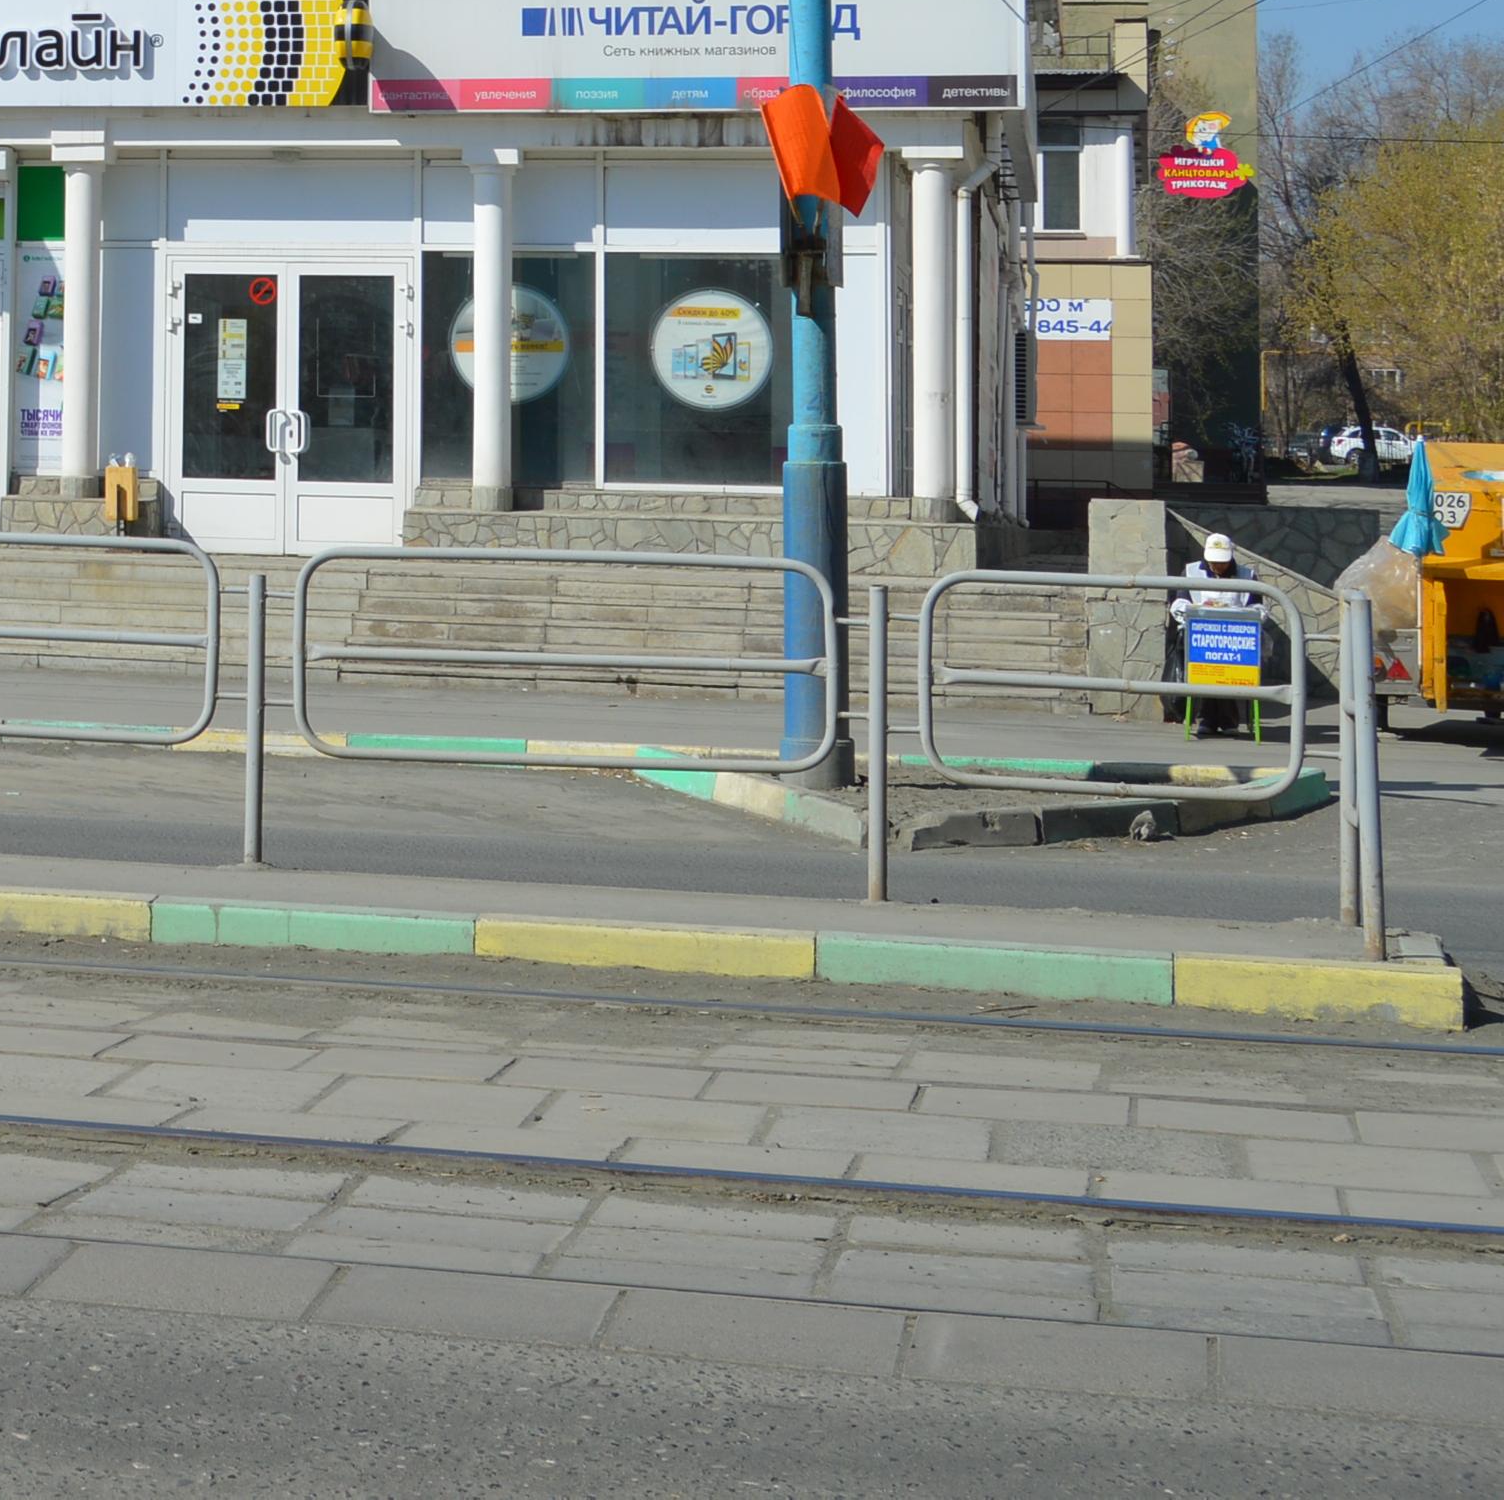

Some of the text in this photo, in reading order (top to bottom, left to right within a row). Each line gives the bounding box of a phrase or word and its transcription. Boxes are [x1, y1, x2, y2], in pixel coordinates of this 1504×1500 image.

[603, 45, 777, 57] Сеть книжных магазинов
[474, 89, 537, 101] увлечения
[575, 89, 618, 100] поэзия
[671, 90, 709, 102] детям
[743, 87, 780, 99] образ
[843, 86, 916, 100] философия
[942, 86, 1010, 99] детективы
[1174, 157, 1225, 167] ИГРУШКИ
[1164, 168, 1233, 178] КАНЦТОВАРЫ
[1171, 180, 1227, 190] ТРИКОТАЖ
[678, 308, 707, 316] Скидки
[720, 309, 737, 317] 40%
[20, 408, 63, 421] ТЫСЯЧИ
[1192, 634, 1256, 651] СТАРОГОРОДСКИЕ
